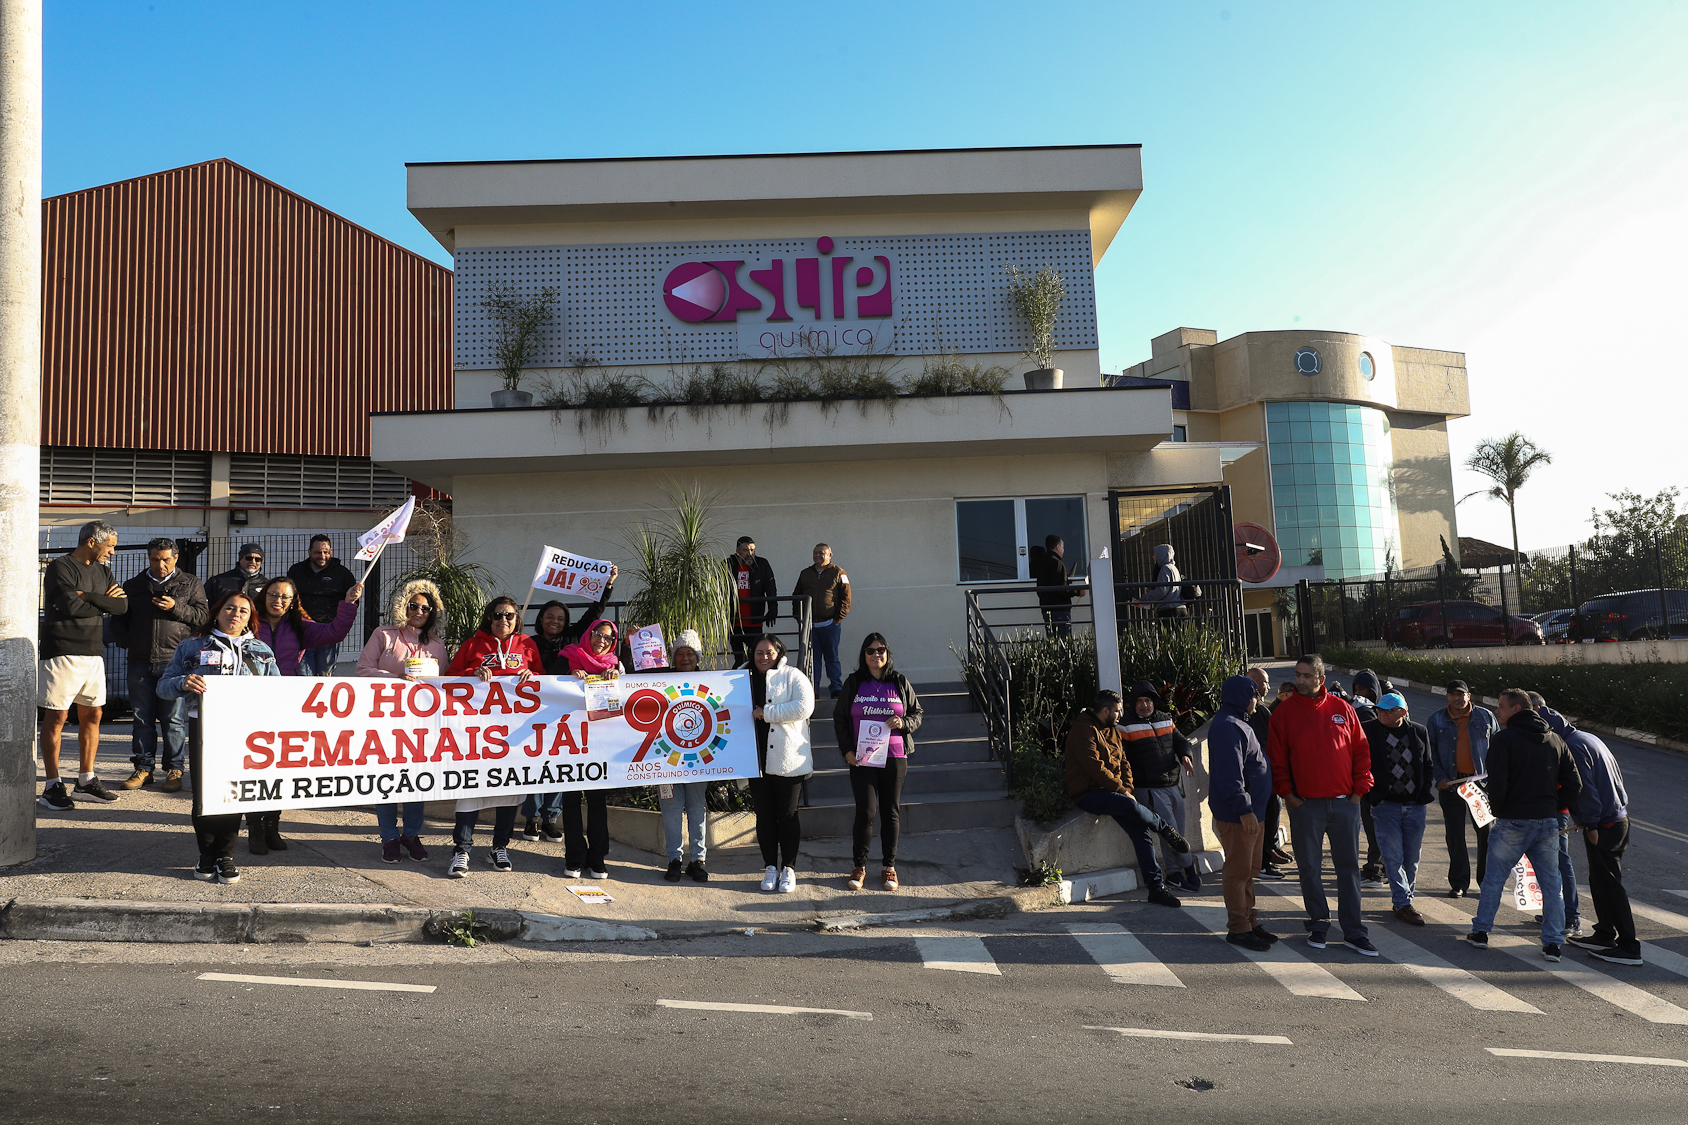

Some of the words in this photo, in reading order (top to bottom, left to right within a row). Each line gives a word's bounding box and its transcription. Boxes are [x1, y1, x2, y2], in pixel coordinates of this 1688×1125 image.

[759, 324, 874, 355] química
[551, 553, 608, 574] REDUÇÃO
[543, 567, 577, 590] JÁ!
[625, 681, 649, 689] RUMO
[301, 681, 356, 718] 40
[368, 680, 541, 718] HORAS
[672, 701, 704, 713] QUÍMICOS
[243, 724, 510, 770] SEMANAIS
[523, 713, 589, 758] JÁ!
[626, 769, 690, 781] CONSTRUINDO
[691, 769, 698, 777] O
[699, 766, 734, 775] FUTURO
[627, 762, 662, 773] ANOS
[223, 778, 284, 802] SEM
[291, 768, 435, 800] REDUÇÃO
[442, 769, 479, 791] DE
[486, 760, 608, 788] SALÁRIO!
